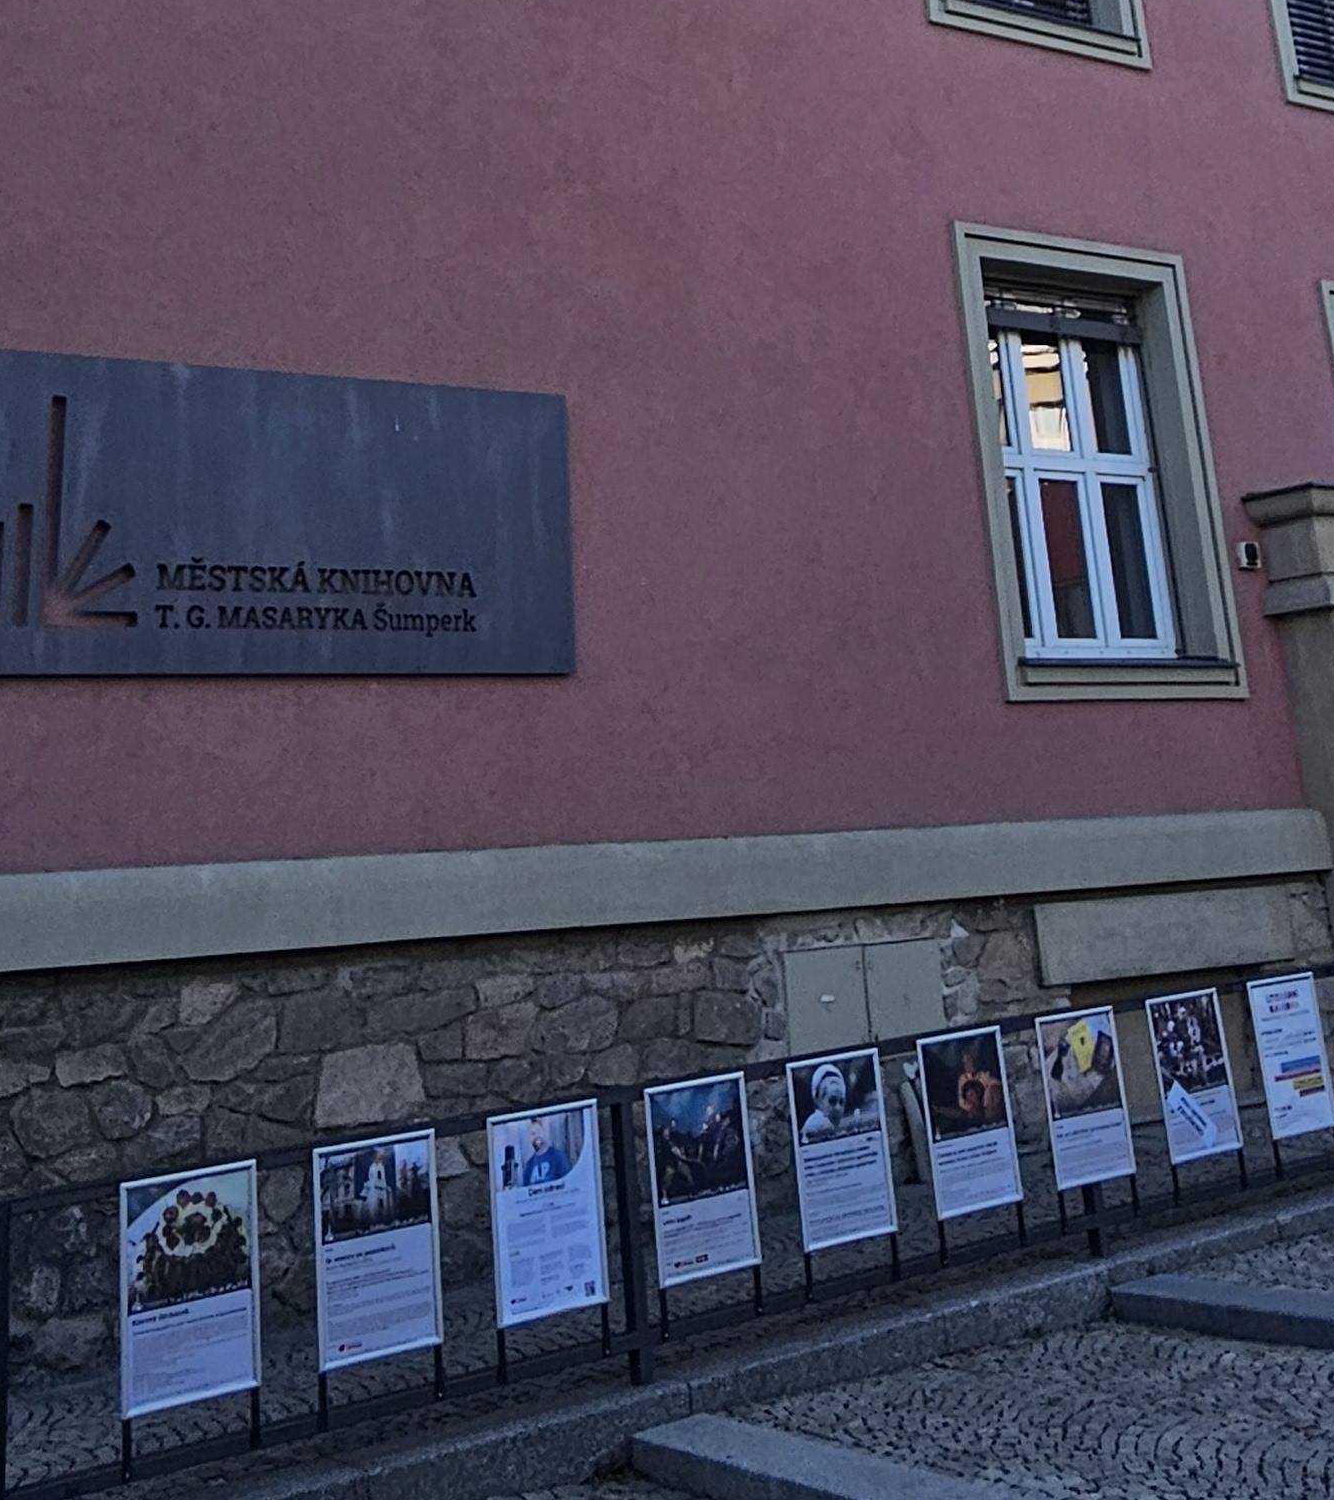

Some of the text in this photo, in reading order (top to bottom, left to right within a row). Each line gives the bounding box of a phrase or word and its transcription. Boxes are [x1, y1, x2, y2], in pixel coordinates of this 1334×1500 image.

[155, 557, 478, 598] MĚSTSKÁ KNIHOVNA
[154, 603, 478, 638] T. G. MASARYKA Šumperk
